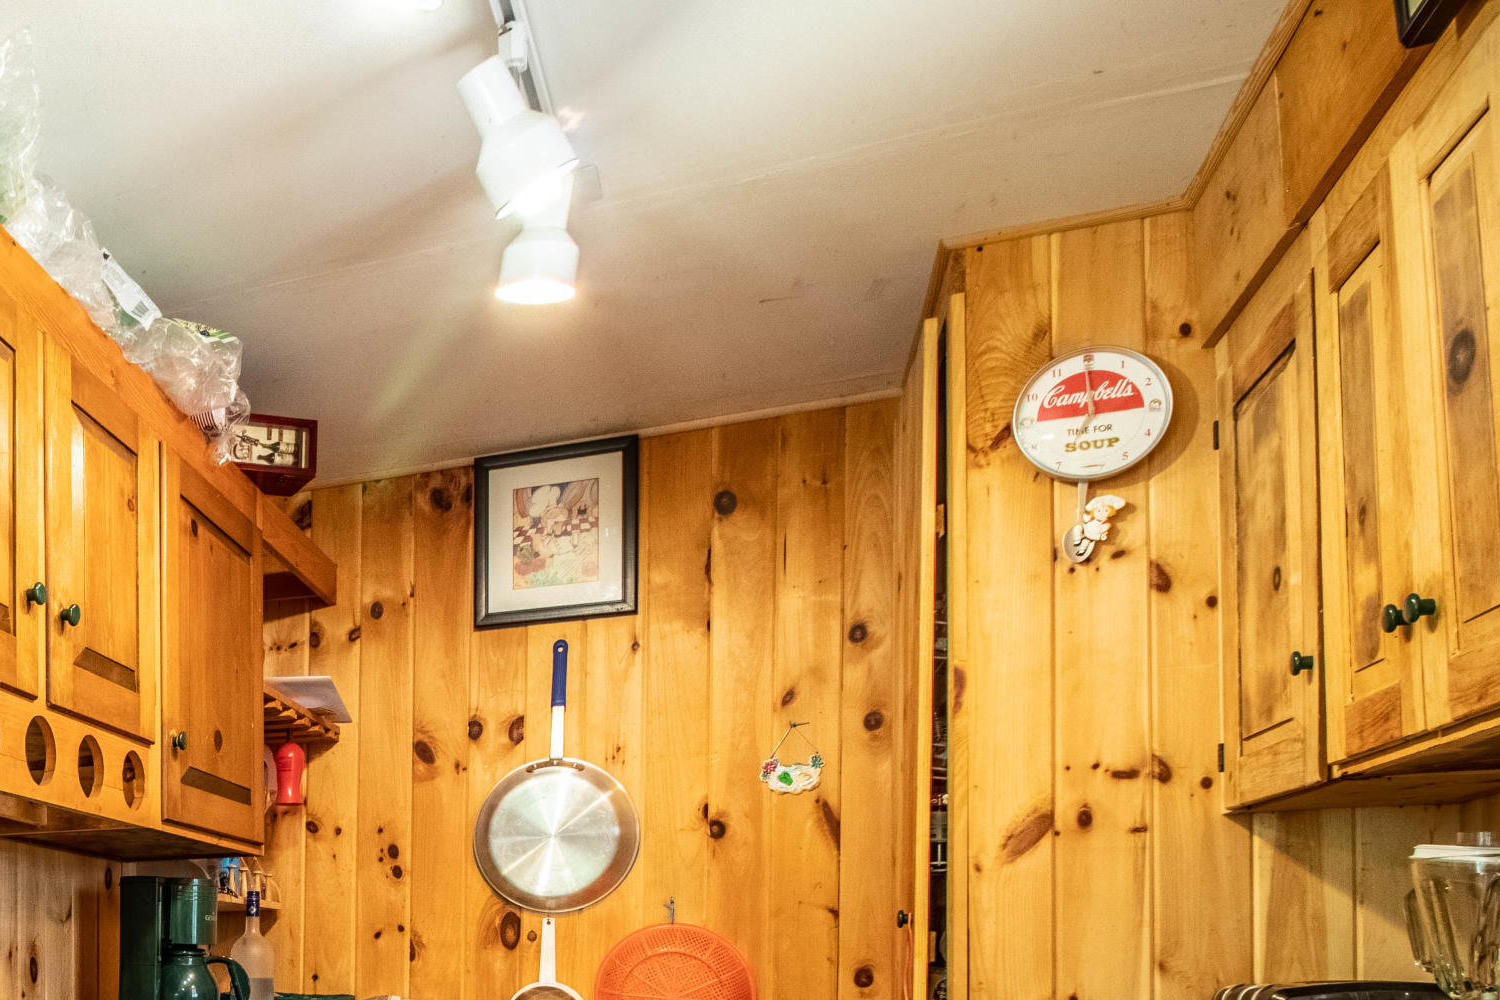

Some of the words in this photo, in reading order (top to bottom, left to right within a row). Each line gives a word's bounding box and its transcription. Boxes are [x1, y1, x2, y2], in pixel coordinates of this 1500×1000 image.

[1120, 360, 1125, 369] 1
[1051, 369, 1062, 378] 11
[1145, 377, 1152, 386] 2
[1043, 379, 1135, 408] Campbell's
[1093, 424, 1113, 433] FOR
[1064, 436, 1120, 453] SOUP
[1122, 451, 1129, 460] 5
[1055, 461, 1062, 472] 7
